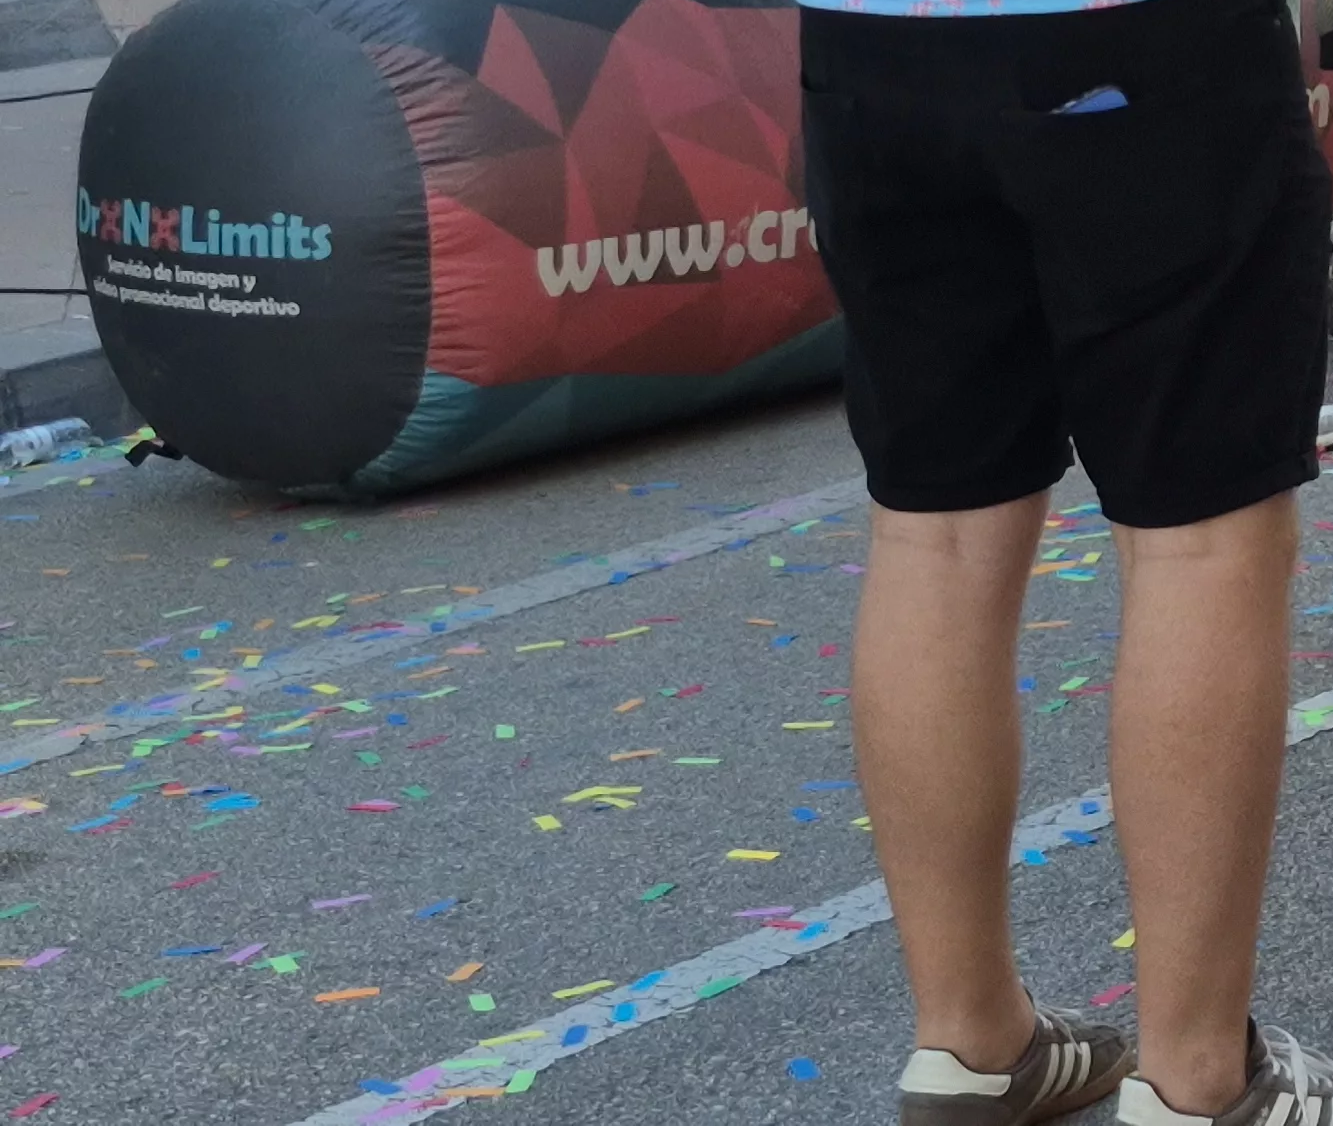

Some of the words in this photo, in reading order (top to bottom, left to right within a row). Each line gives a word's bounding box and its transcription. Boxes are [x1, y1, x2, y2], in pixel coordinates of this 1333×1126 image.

[537, 207, 819, 298] www.cr
[154, 262, 173, 283] de
[242, 275, 257, 294] y
[208, 294, 301, 317] deportivo
